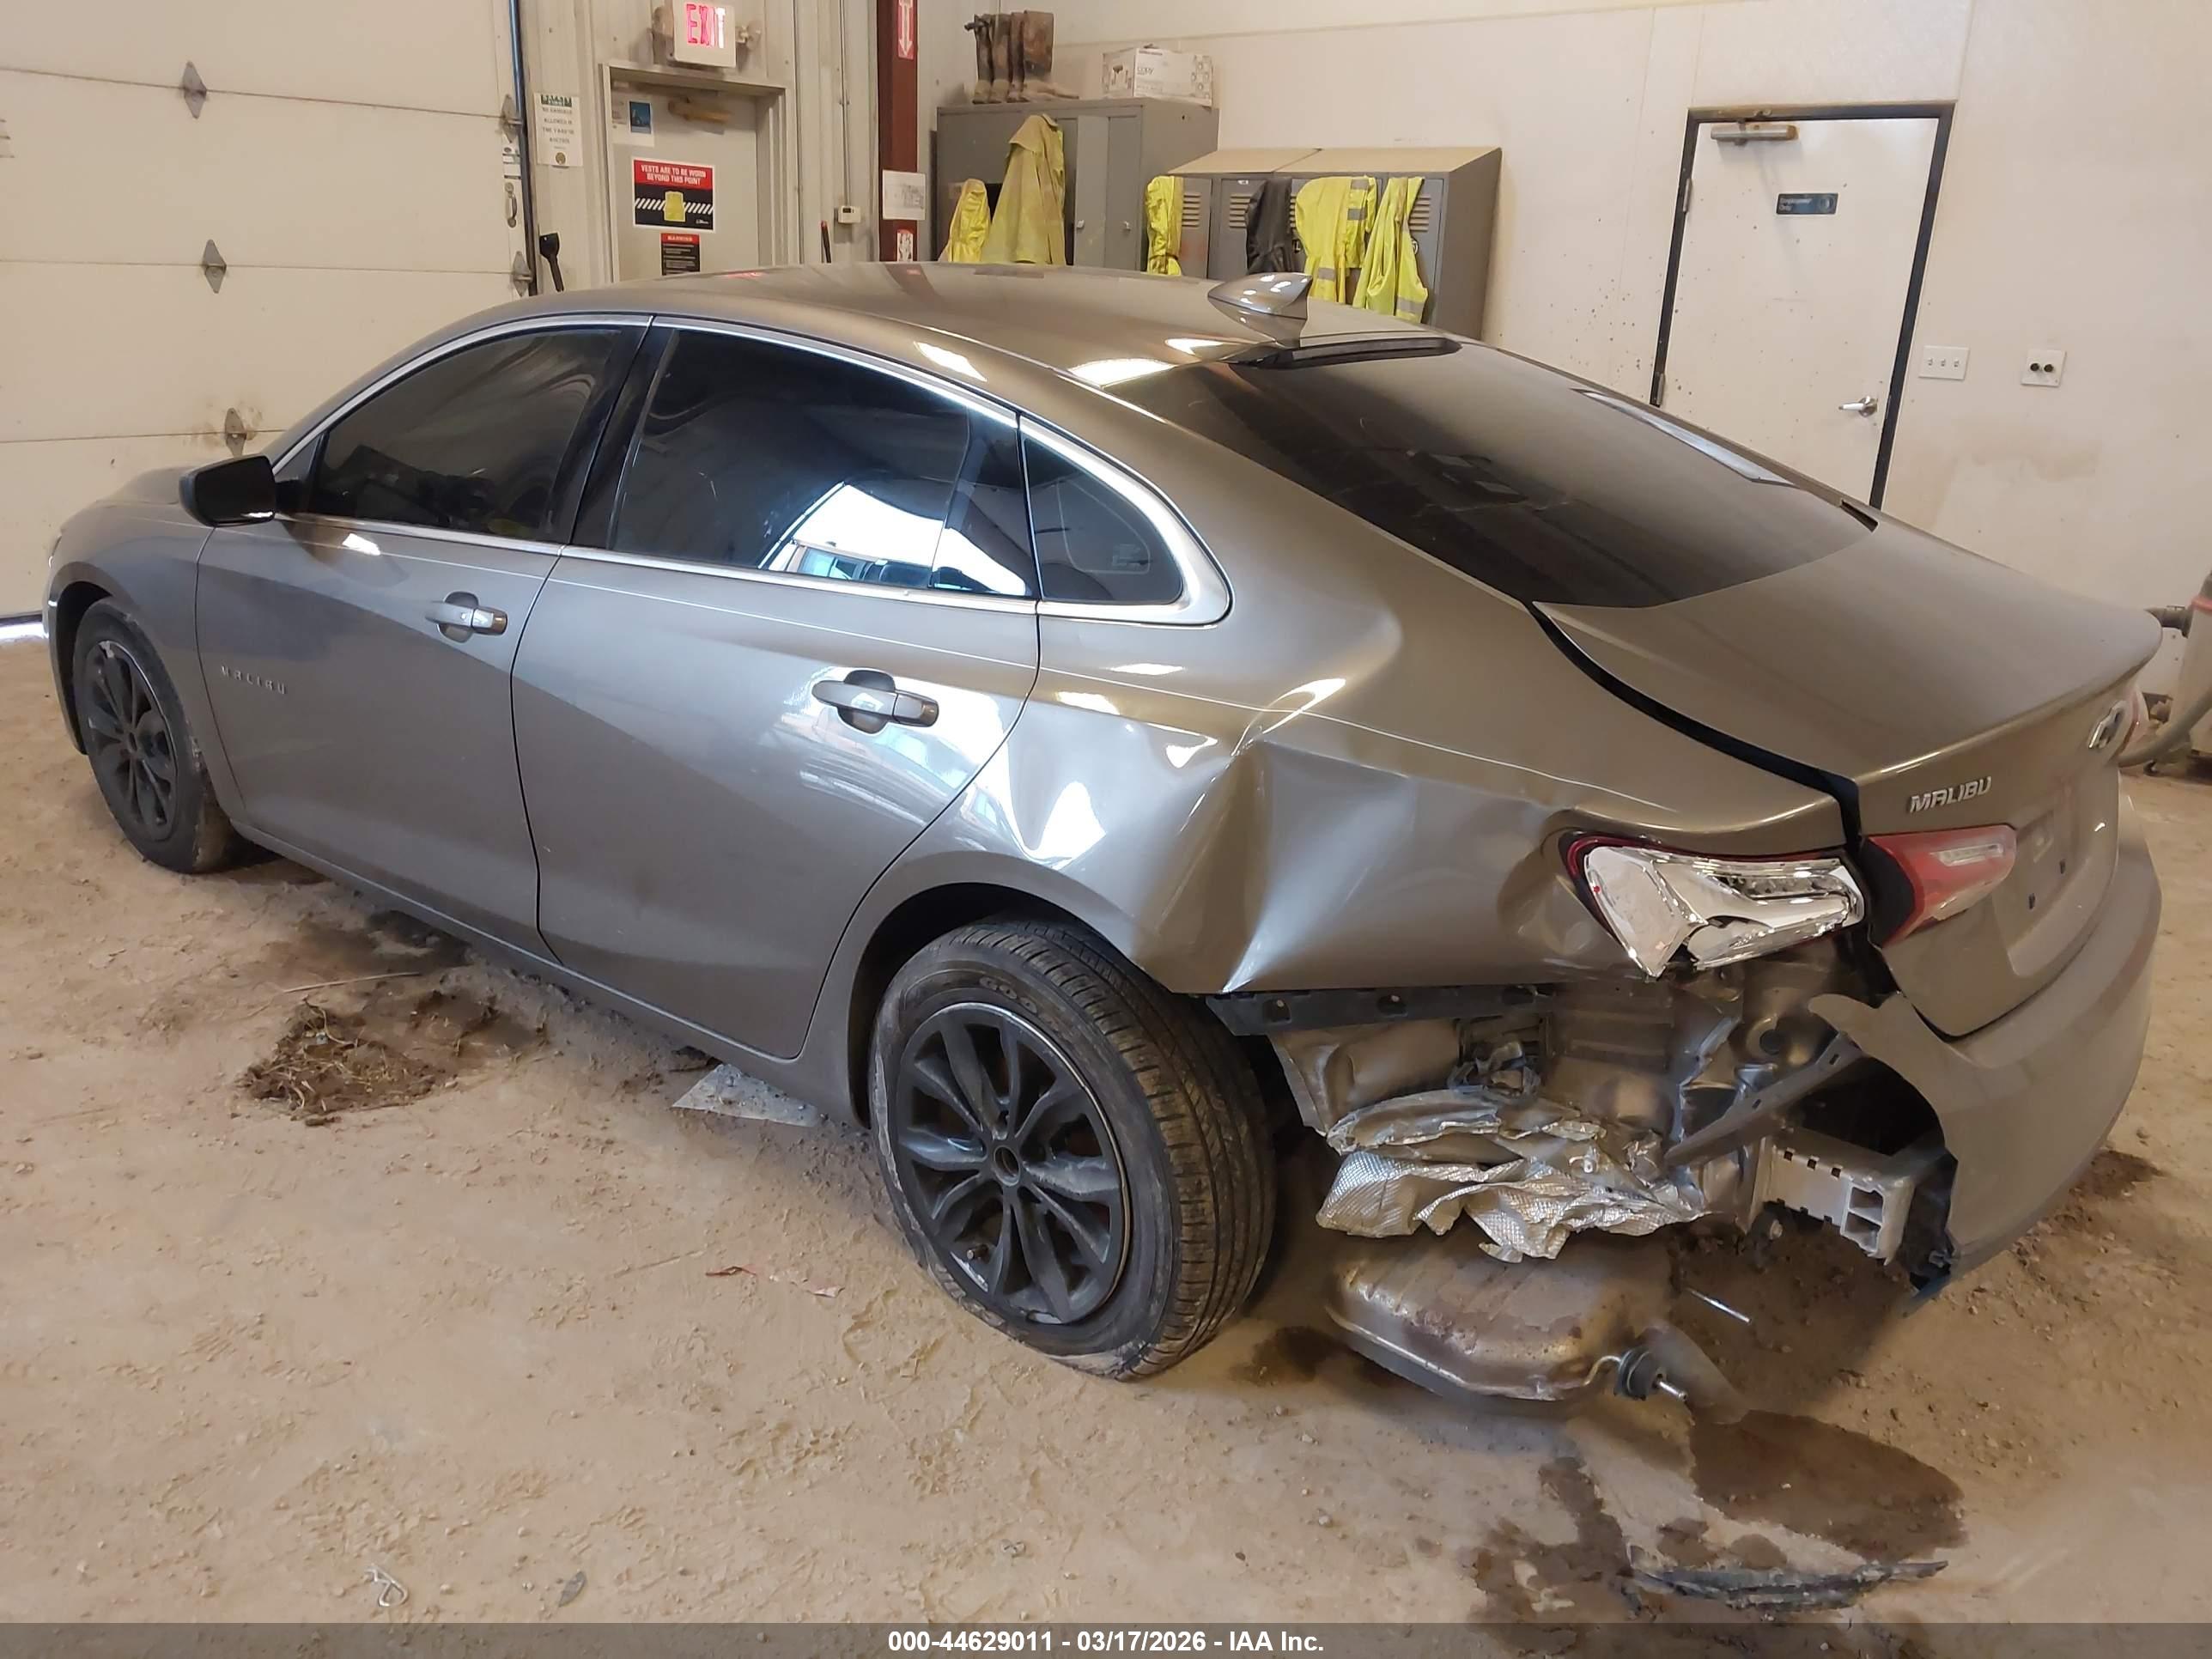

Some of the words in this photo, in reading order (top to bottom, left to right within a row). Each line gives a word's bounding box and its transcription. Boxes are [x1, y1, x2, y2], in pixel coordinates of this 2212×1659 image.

[686, 3, 726, 48] EXIT
[641, 165, 659, 173] VESTS
[647, 173, 670, 182] BEYOND
[671, 175, 684, 184] THIS
[684, 177, 701, 185] POINT
[222, 665, 285, 694] MALIBU
[1908, 775, 1992, 813] MALIBU
